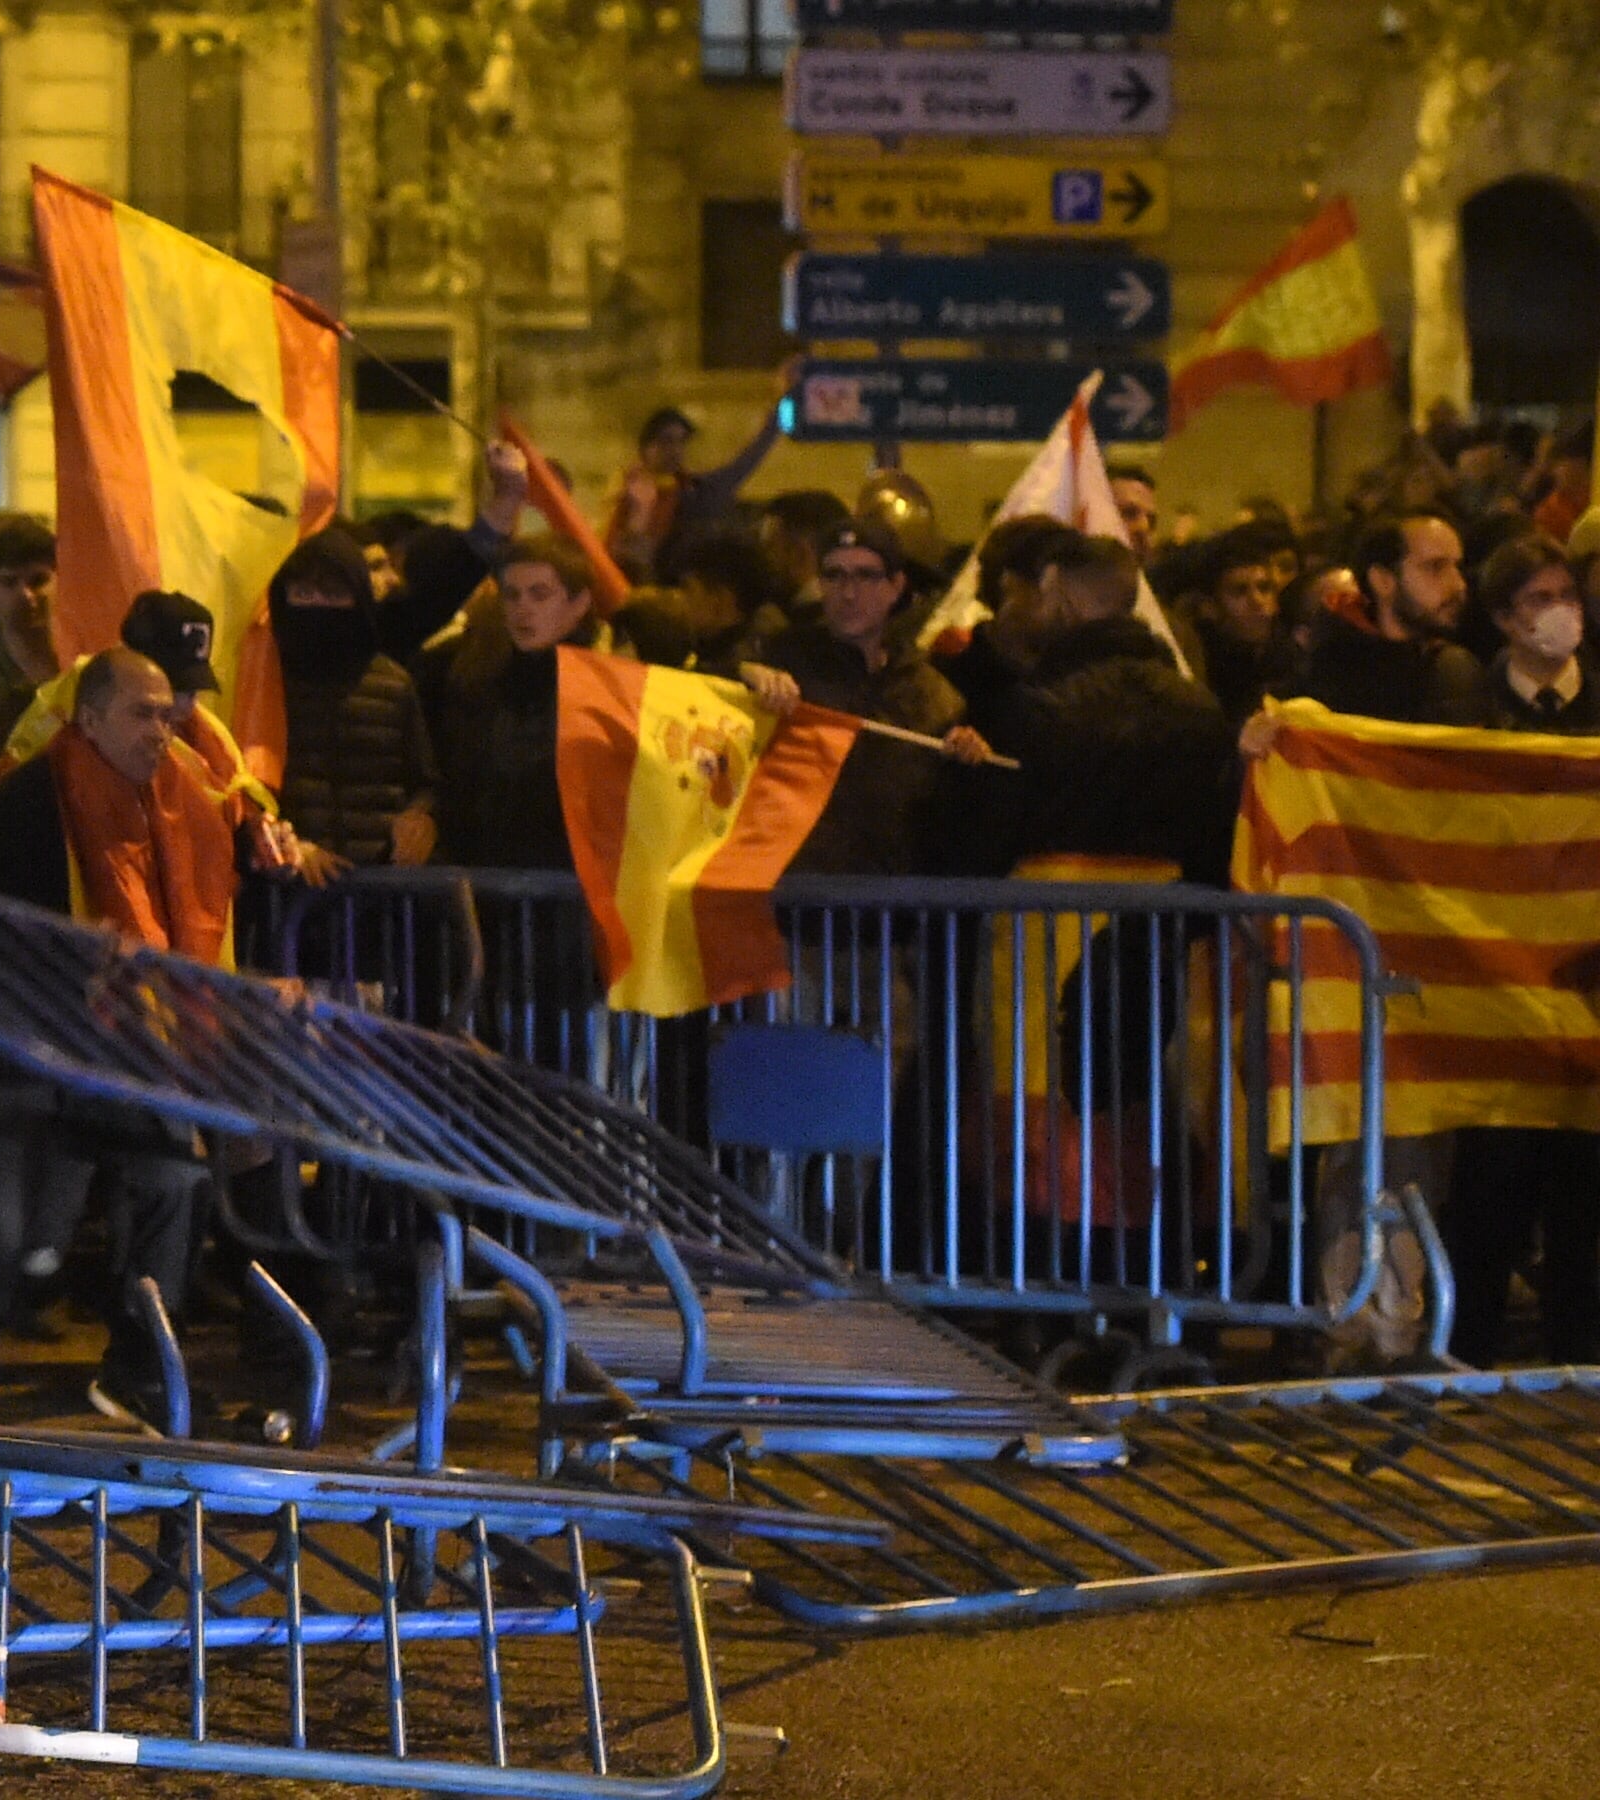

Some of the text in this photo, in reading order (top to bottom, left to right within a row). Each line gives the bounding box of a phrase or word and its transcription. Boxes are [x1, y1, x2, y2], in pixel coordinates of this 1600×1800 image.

[809, 90, 1018, 118] Conde Duque
[859, 194, 899, 219] de
[1061, 175, 1093, 221] P
[808, 296, 1066, 331] Alberto Aguilera
